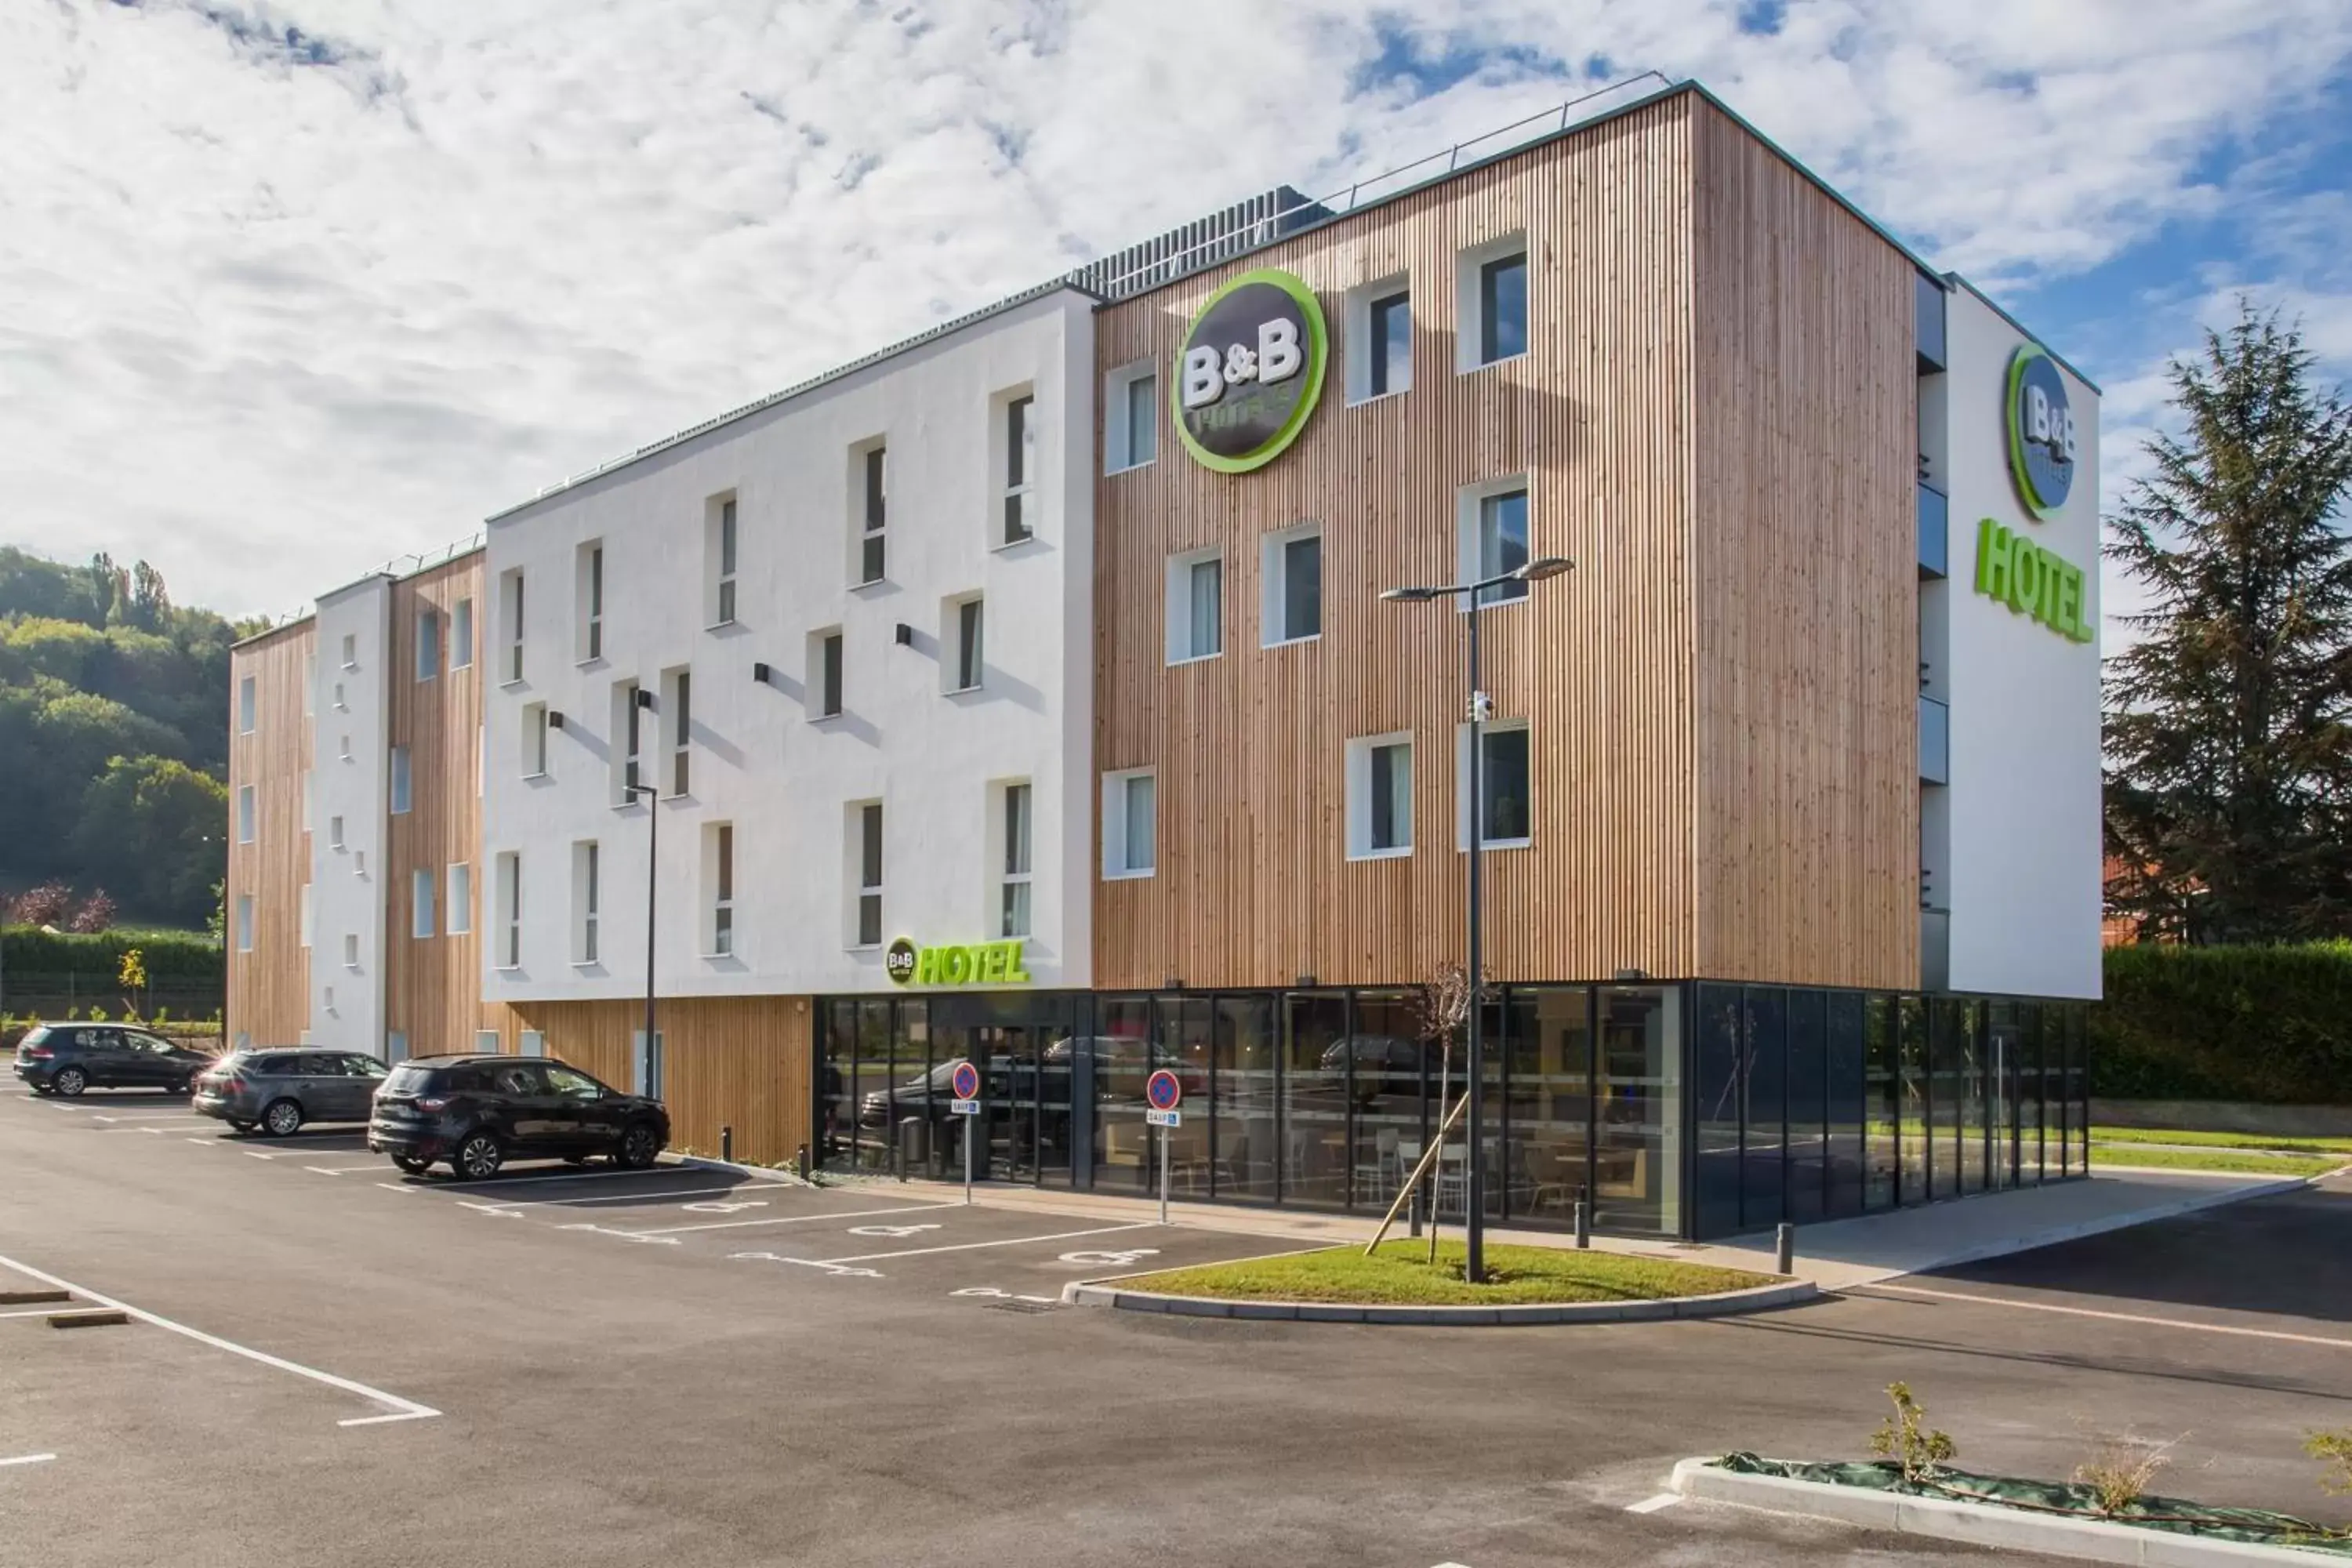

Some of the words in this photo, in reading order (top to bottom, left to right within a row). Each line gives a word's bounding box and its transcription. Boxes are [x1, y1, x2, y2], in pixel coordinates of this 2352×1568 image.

[1184, 317, 1301, 408] B&B
[2026, 384, 2076, 461] B&B
[1975, 518, 2094, 644] HOTEL
[916, 942, 1030, 985] HOTEL
